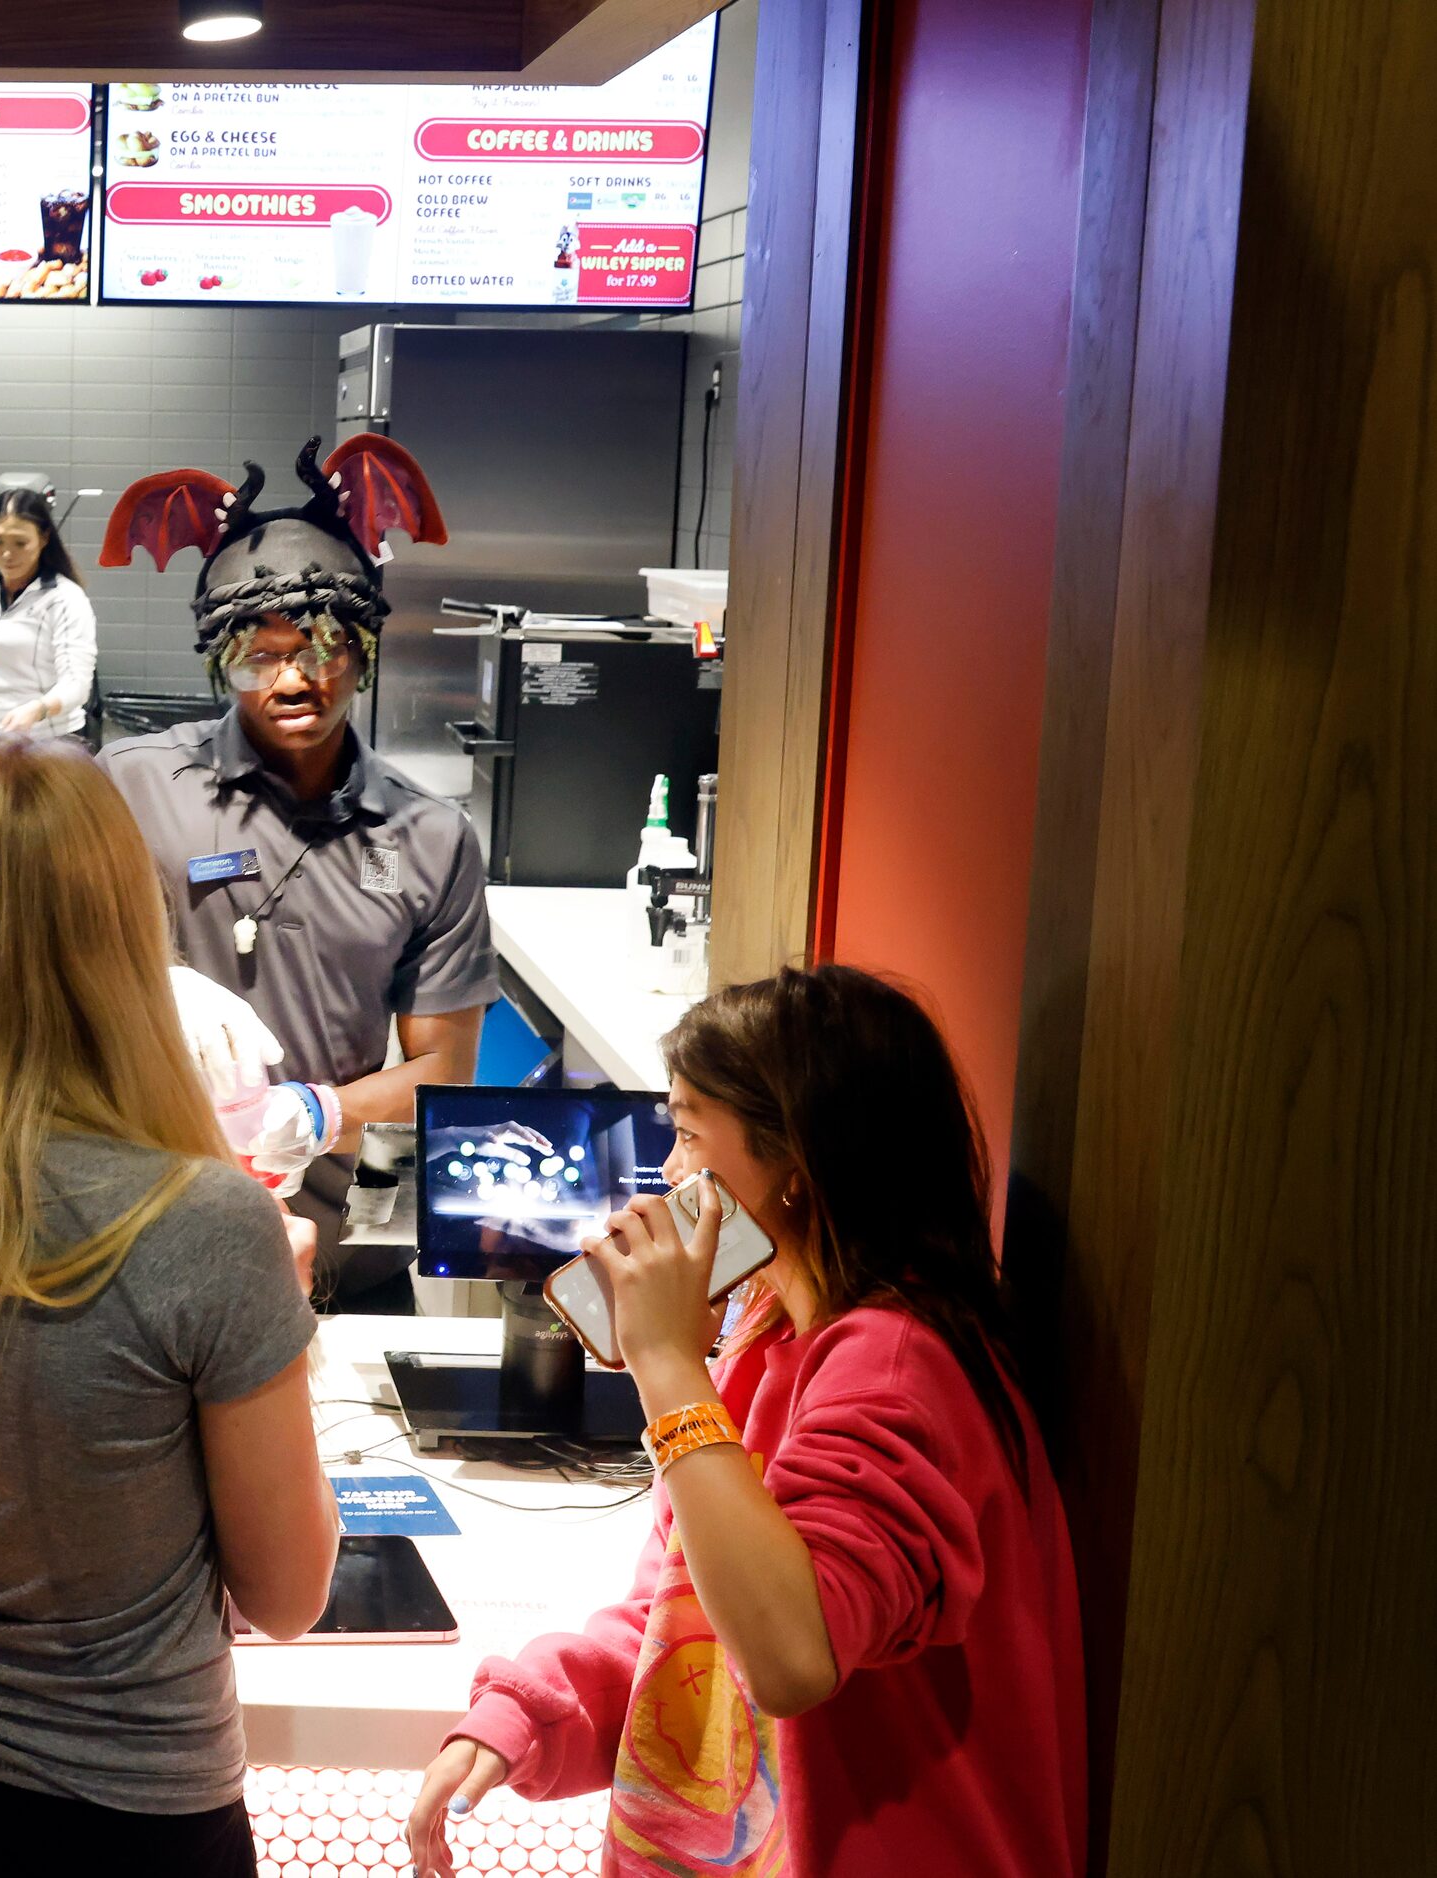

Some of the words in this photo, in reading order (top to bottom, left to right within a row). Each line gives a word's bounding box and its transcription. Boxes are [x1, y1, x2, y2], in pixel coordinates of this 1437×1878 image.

[172, 92, 188, 102] ON
[193, 92, 201, 102] A
[204, 92, 252, 103] PRETZEL
[256, 93, 280, 103] BUN
[171, 130, 201, 143] EGG
[205, 131, 216, 143] &
[221, 131, 278, 144] CHEESE
[467, 129, 549, 151] COFFEE
[553, 131, 568, 151] &
[573, 130, 654, 152] DRINKS
[170, 147, 186, 156] ON
[191, 147, 199, 156] A
[202, 147, 250, 158] PRETZEL
[254, 148, 278, 158] BUN
[418, 175, 444, 186] HOT
[448, 175, 493, 186] COFFEE
[569, 176, 601, 187] SOFT
[606, 176, 653, 188] DRINKS
[179, 193, 316, 217] SMOOTHIES
[417, 194, 449, 206] COLD
[452, 194, 489, 205] BREW
[416, 207, 462, 219] COFFEE
[613, 238, 645, 253] Add
[645, 242, 658, 253] a
[581, 256, 630, 271] WILEY
[631, 256, 685, 271] SIPPER
[411, 275, 465, 286] BOTTLED
[469, 275, 514, 287] WATER
[606, 275, 624, 287] for
[626, 275, 657, 287] 17.99
[373, 1490, 416, 1498] YOUR
